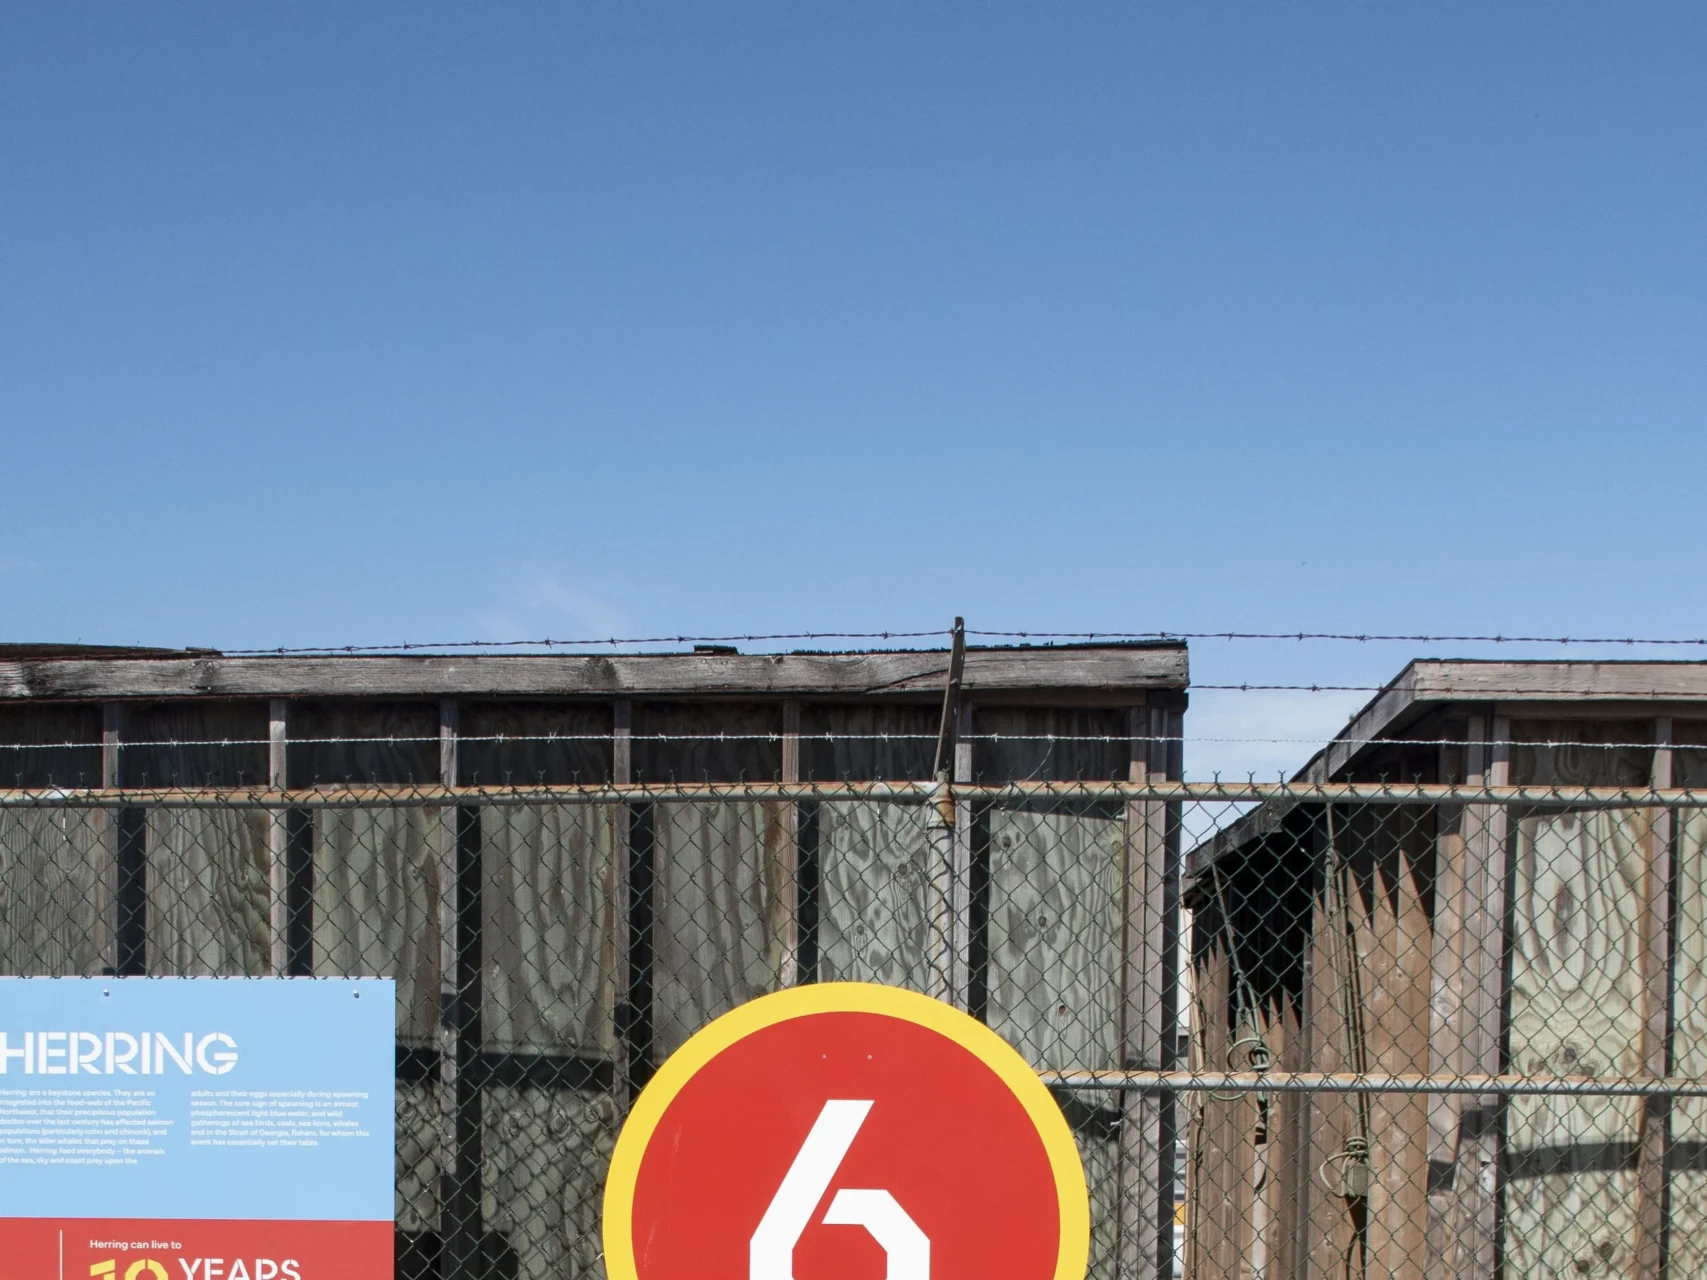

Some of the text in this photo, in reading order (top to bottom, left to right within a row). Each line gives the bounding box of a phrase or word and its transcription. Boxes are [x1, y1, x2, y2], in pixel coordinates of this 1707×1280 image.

[0, 1032, 238, 1075] HERRING
[48, 1089, 81, 1097] keystone
[113, 1090, 133, 1098] They
[269, 1090, 305, 1098] especially
[307, 1091, 331, 1099] during
[333, 1091, 368, 1099] spawning
[252, 1100, 267, 1108] sign
[278, 1100, 313, 1108] spawning
[74, 1109, 115, 1117] precipitous
[117, 1109, 156, 1117] population
[190, 1110, 250, 1118] phosphorescent
[252, 1110, 268, 1118] light
[71, 1118, 100, 1126] century
[190, 1119, 230, 1127] gatherings
[227, 1139, 265, 1147] essentially
[30, 1147, 57, 1155] Herring
[76, 1148, 115, 1156] everybody
[36, 1157, 48, 1165] sky
[90, 1240, 128, 1251] Herring
[152, 1240, 168, 1249] live
[172, 1241, 182, 1249] to
